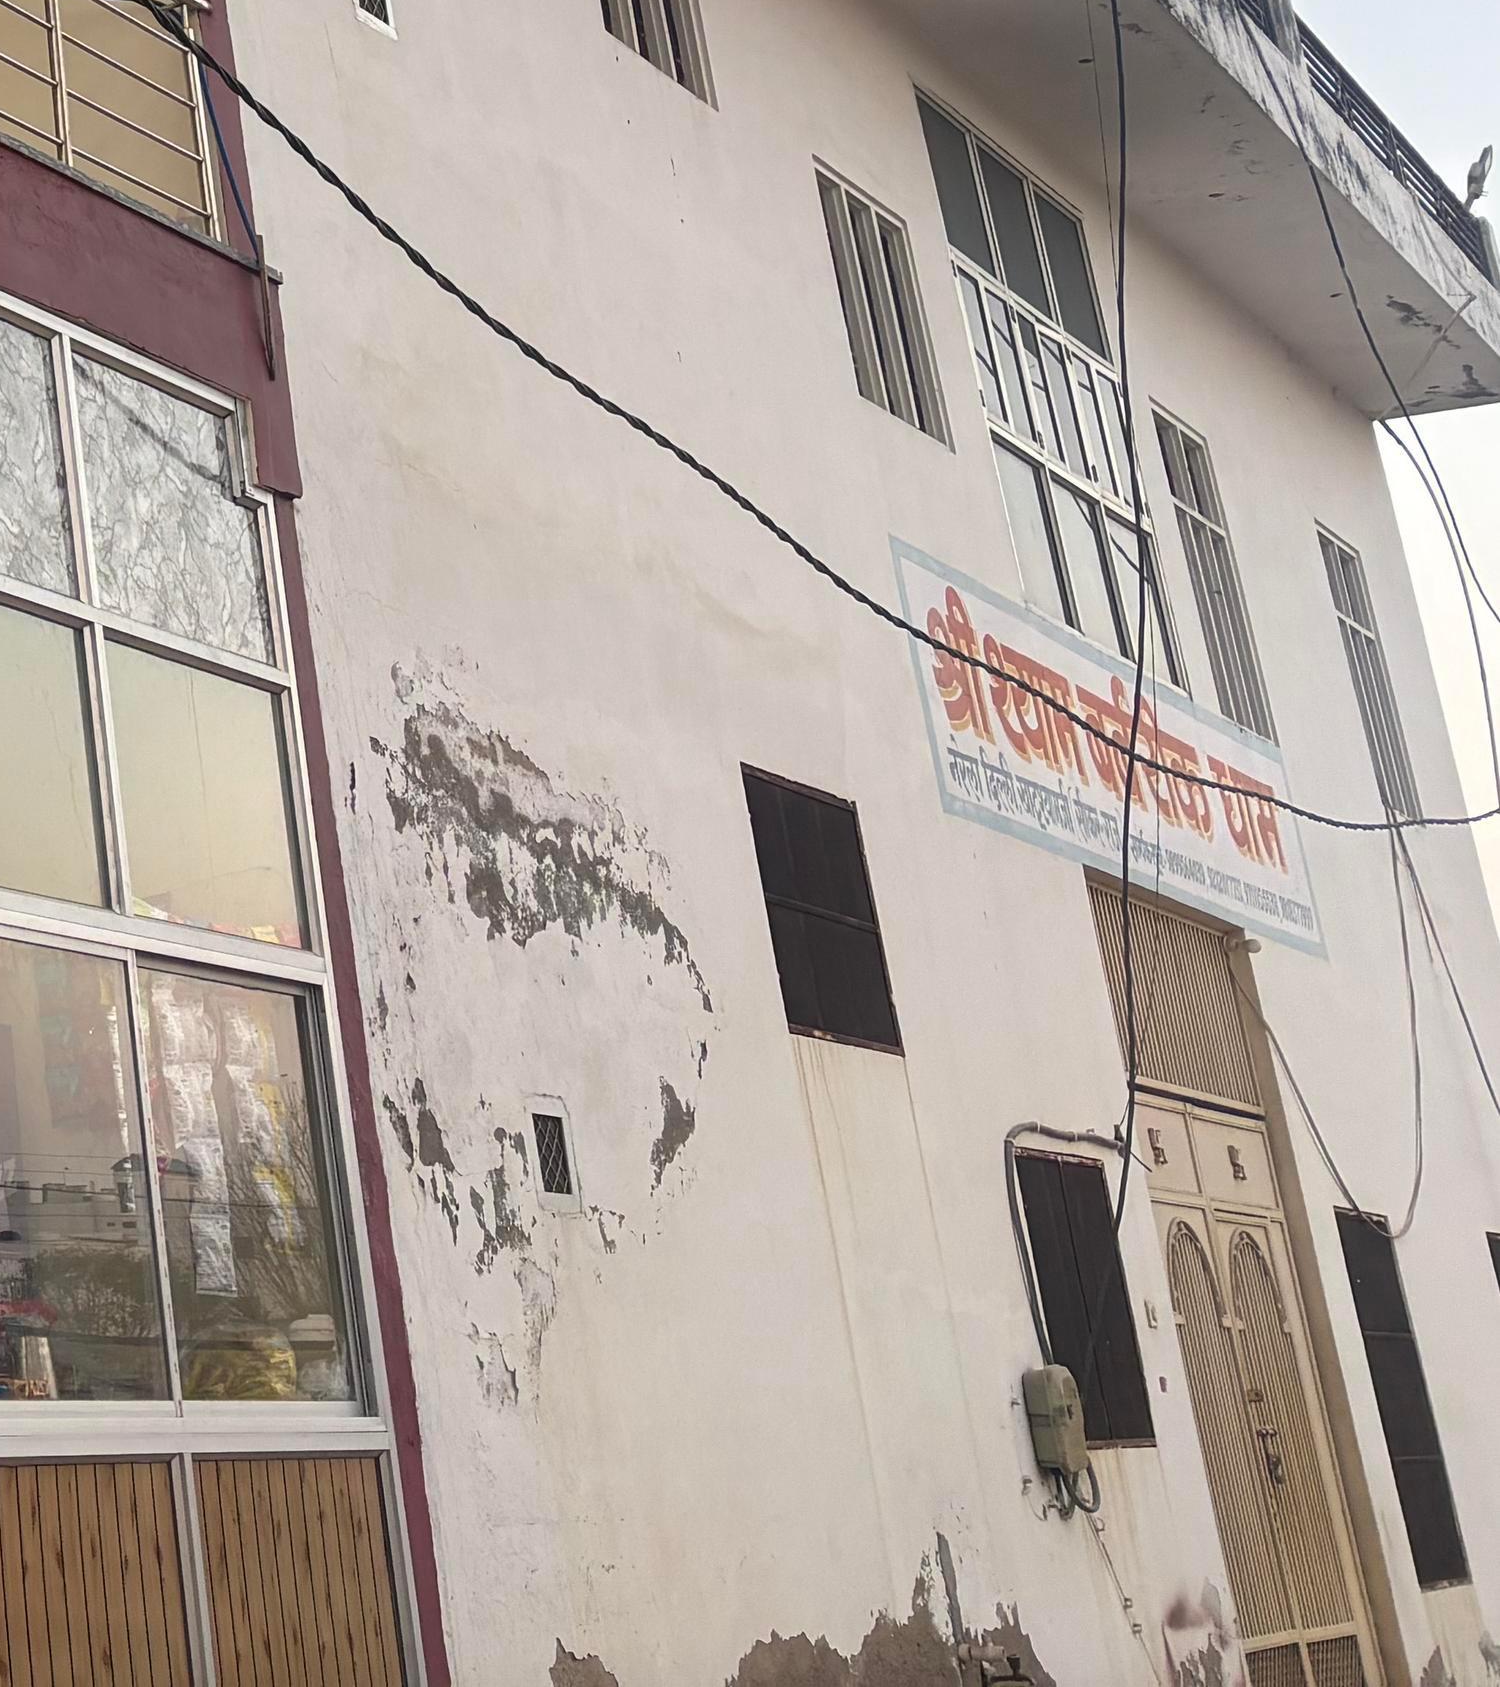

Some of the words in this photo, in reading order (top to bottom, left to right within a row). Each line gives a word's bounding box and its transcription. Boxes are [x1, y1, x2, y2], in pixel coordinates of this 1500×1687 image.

[926, 585, 997, 747] श्री
[982, 632, 1091, 788] श्याम
[1205, 753, 1290, 876] धाम
